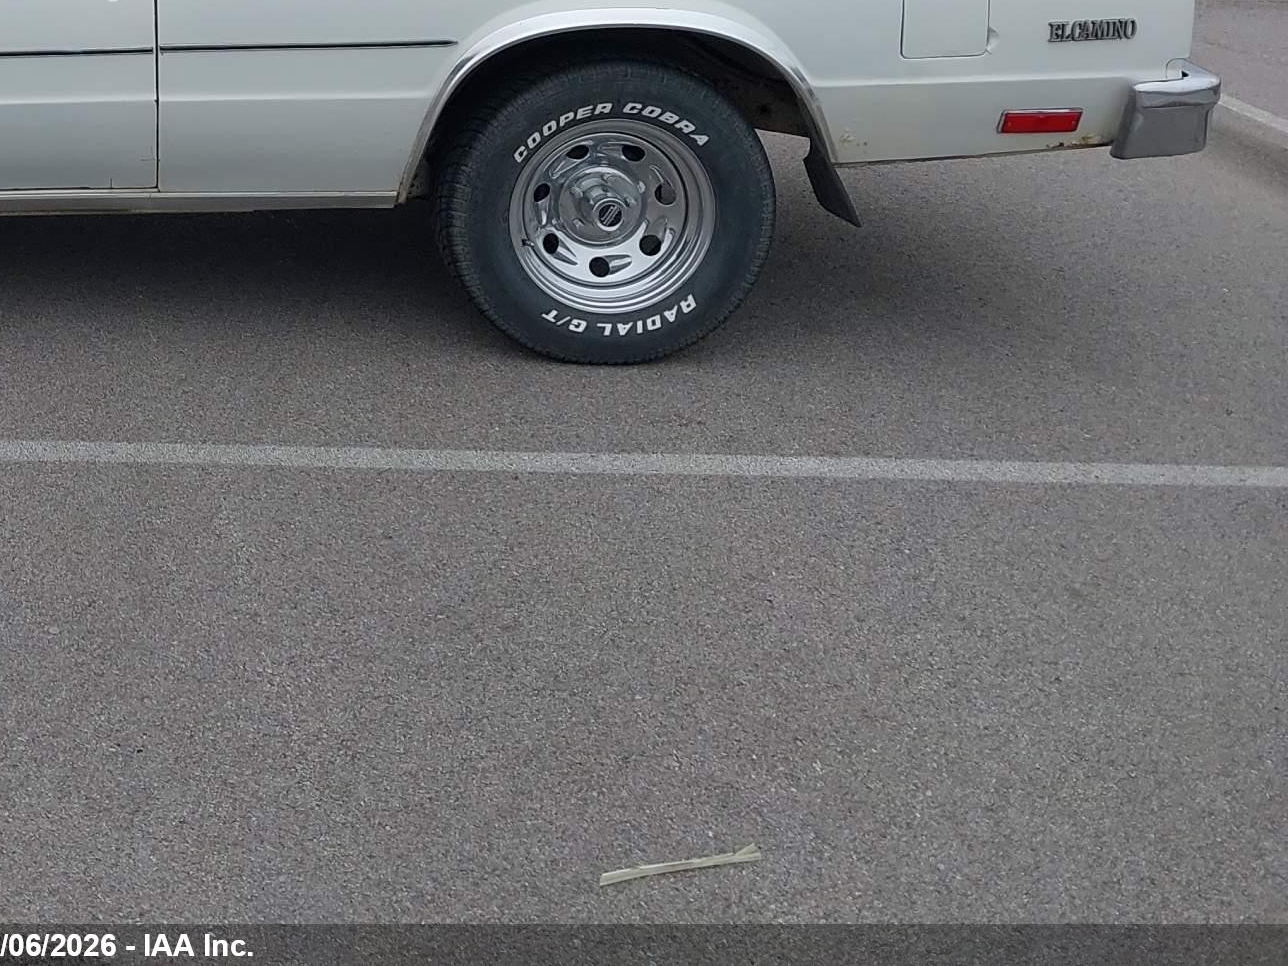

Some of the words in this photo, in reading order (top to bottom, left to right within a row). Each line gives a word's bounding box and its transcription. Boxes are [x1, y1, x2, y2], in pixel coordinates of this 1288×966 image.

[514, 102, 612, 163] COOPER
[623, 102, 710, 147] COBRA
[541, 309, 588, 333] G/T
[596, 294, 697, 336] RADIAL
